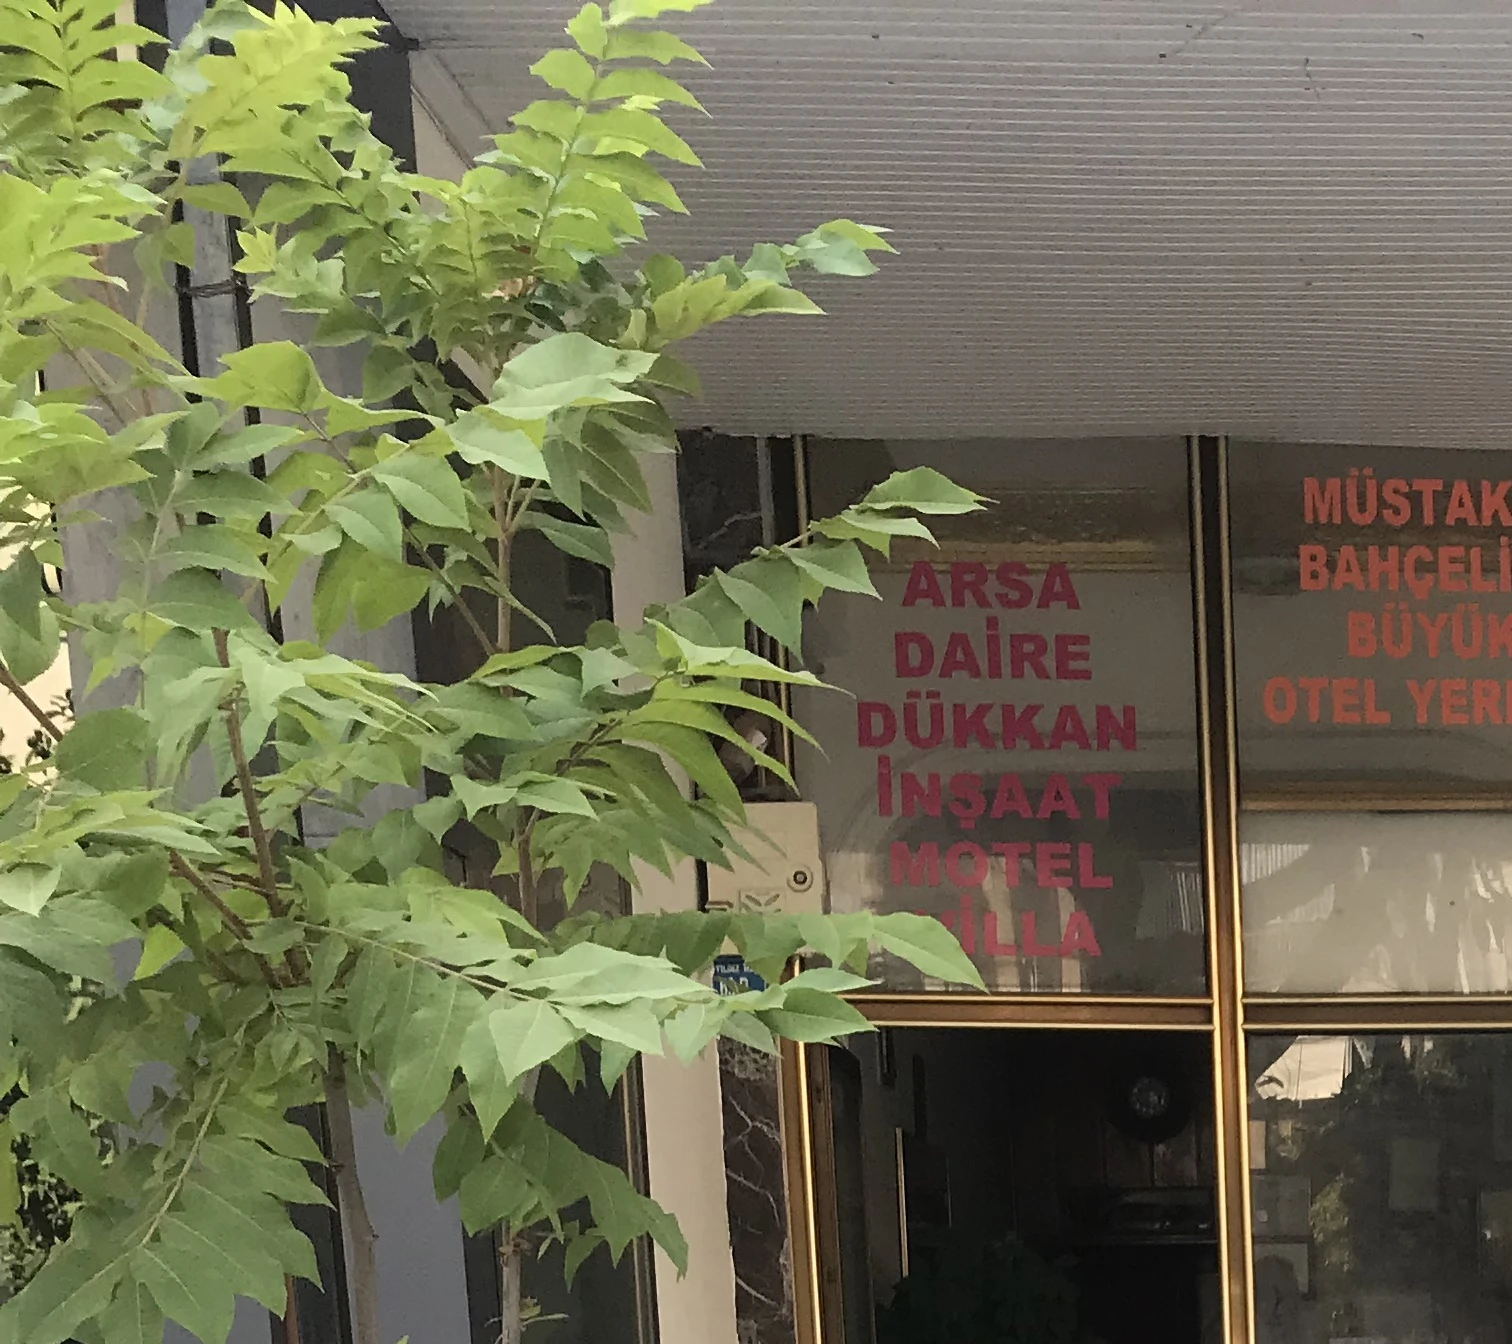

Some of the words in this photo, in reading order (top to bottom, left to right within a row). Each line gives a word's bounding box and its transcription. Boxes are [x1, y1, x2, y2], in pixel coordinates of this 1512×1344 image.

[902, 560, 1081, 611] ARSA
[1298, 535, 1511, 601] BAHÇELİ
[893, 615, 1092, 681] DAİRE
[856, 690, 1138, 752] DÜKKAN
[1262, 676, 1391, 725] OTEL
[877, 754, 1123, 830] İNŞAAT
[889, 841, 1114, 889] MOTEL
